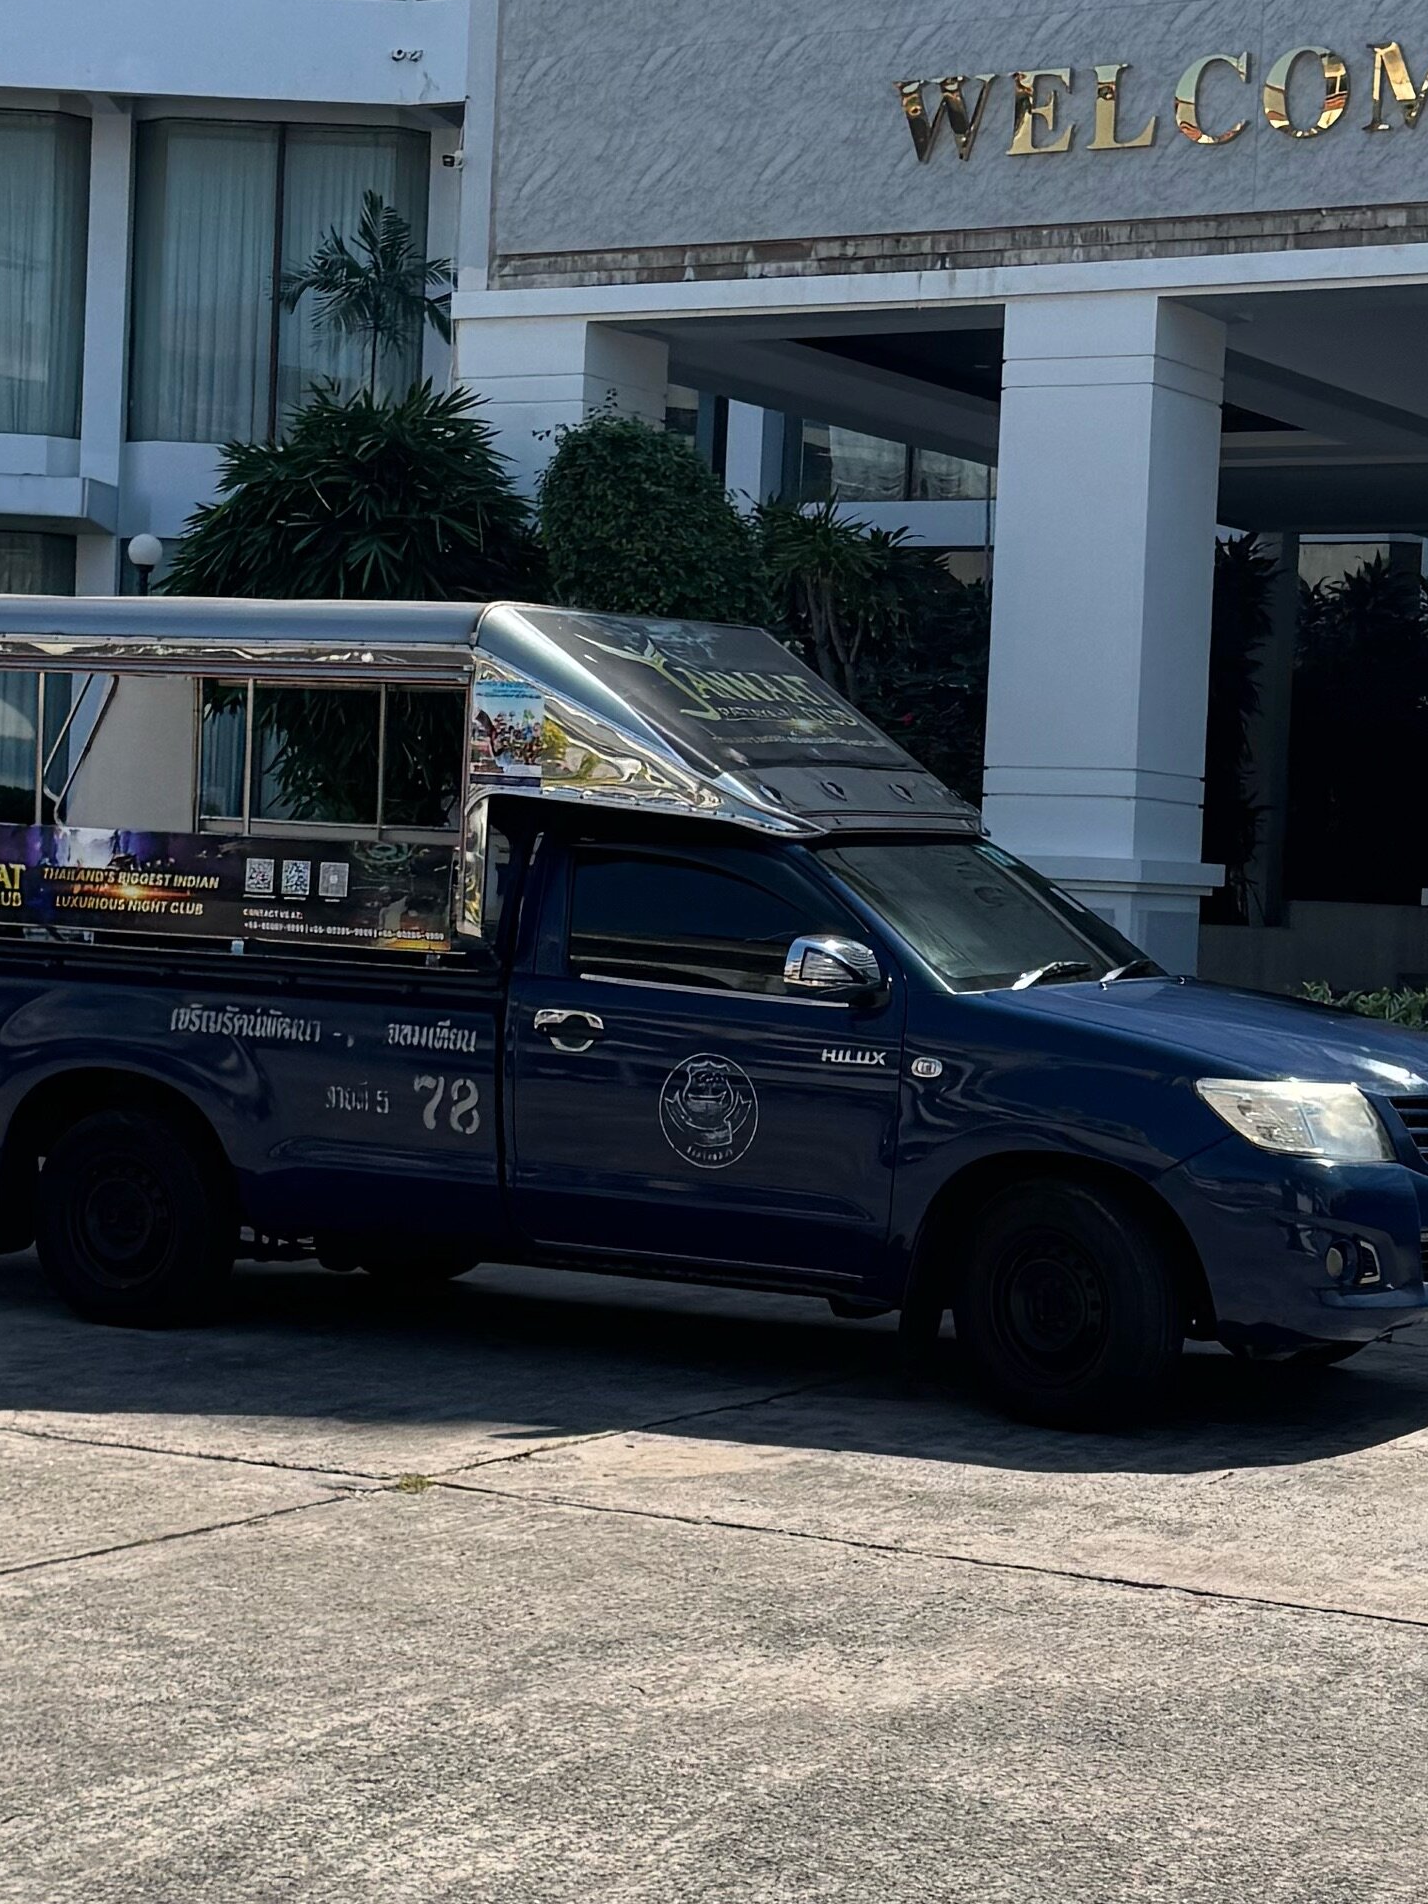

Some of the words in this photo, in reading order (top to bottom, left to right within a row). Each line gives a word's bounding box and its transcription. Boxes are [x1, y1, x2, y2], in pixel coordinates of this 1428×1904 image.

[43, 867, 116, 884] THAILAND'S
[117, 871, 172, 887] BIGGEST
[173, 874, 220, 889] INDIAN
[55, 895, 125, 911] LUXURIOUS
[126, 898, 167, 914] NIGHT
[169, 901, 204, 916] CLUB
[821, 1048, 887, 1066] HILUX
[376, 1090, 389, 1114] 5
[413, 1074, 480, 1135] 78
